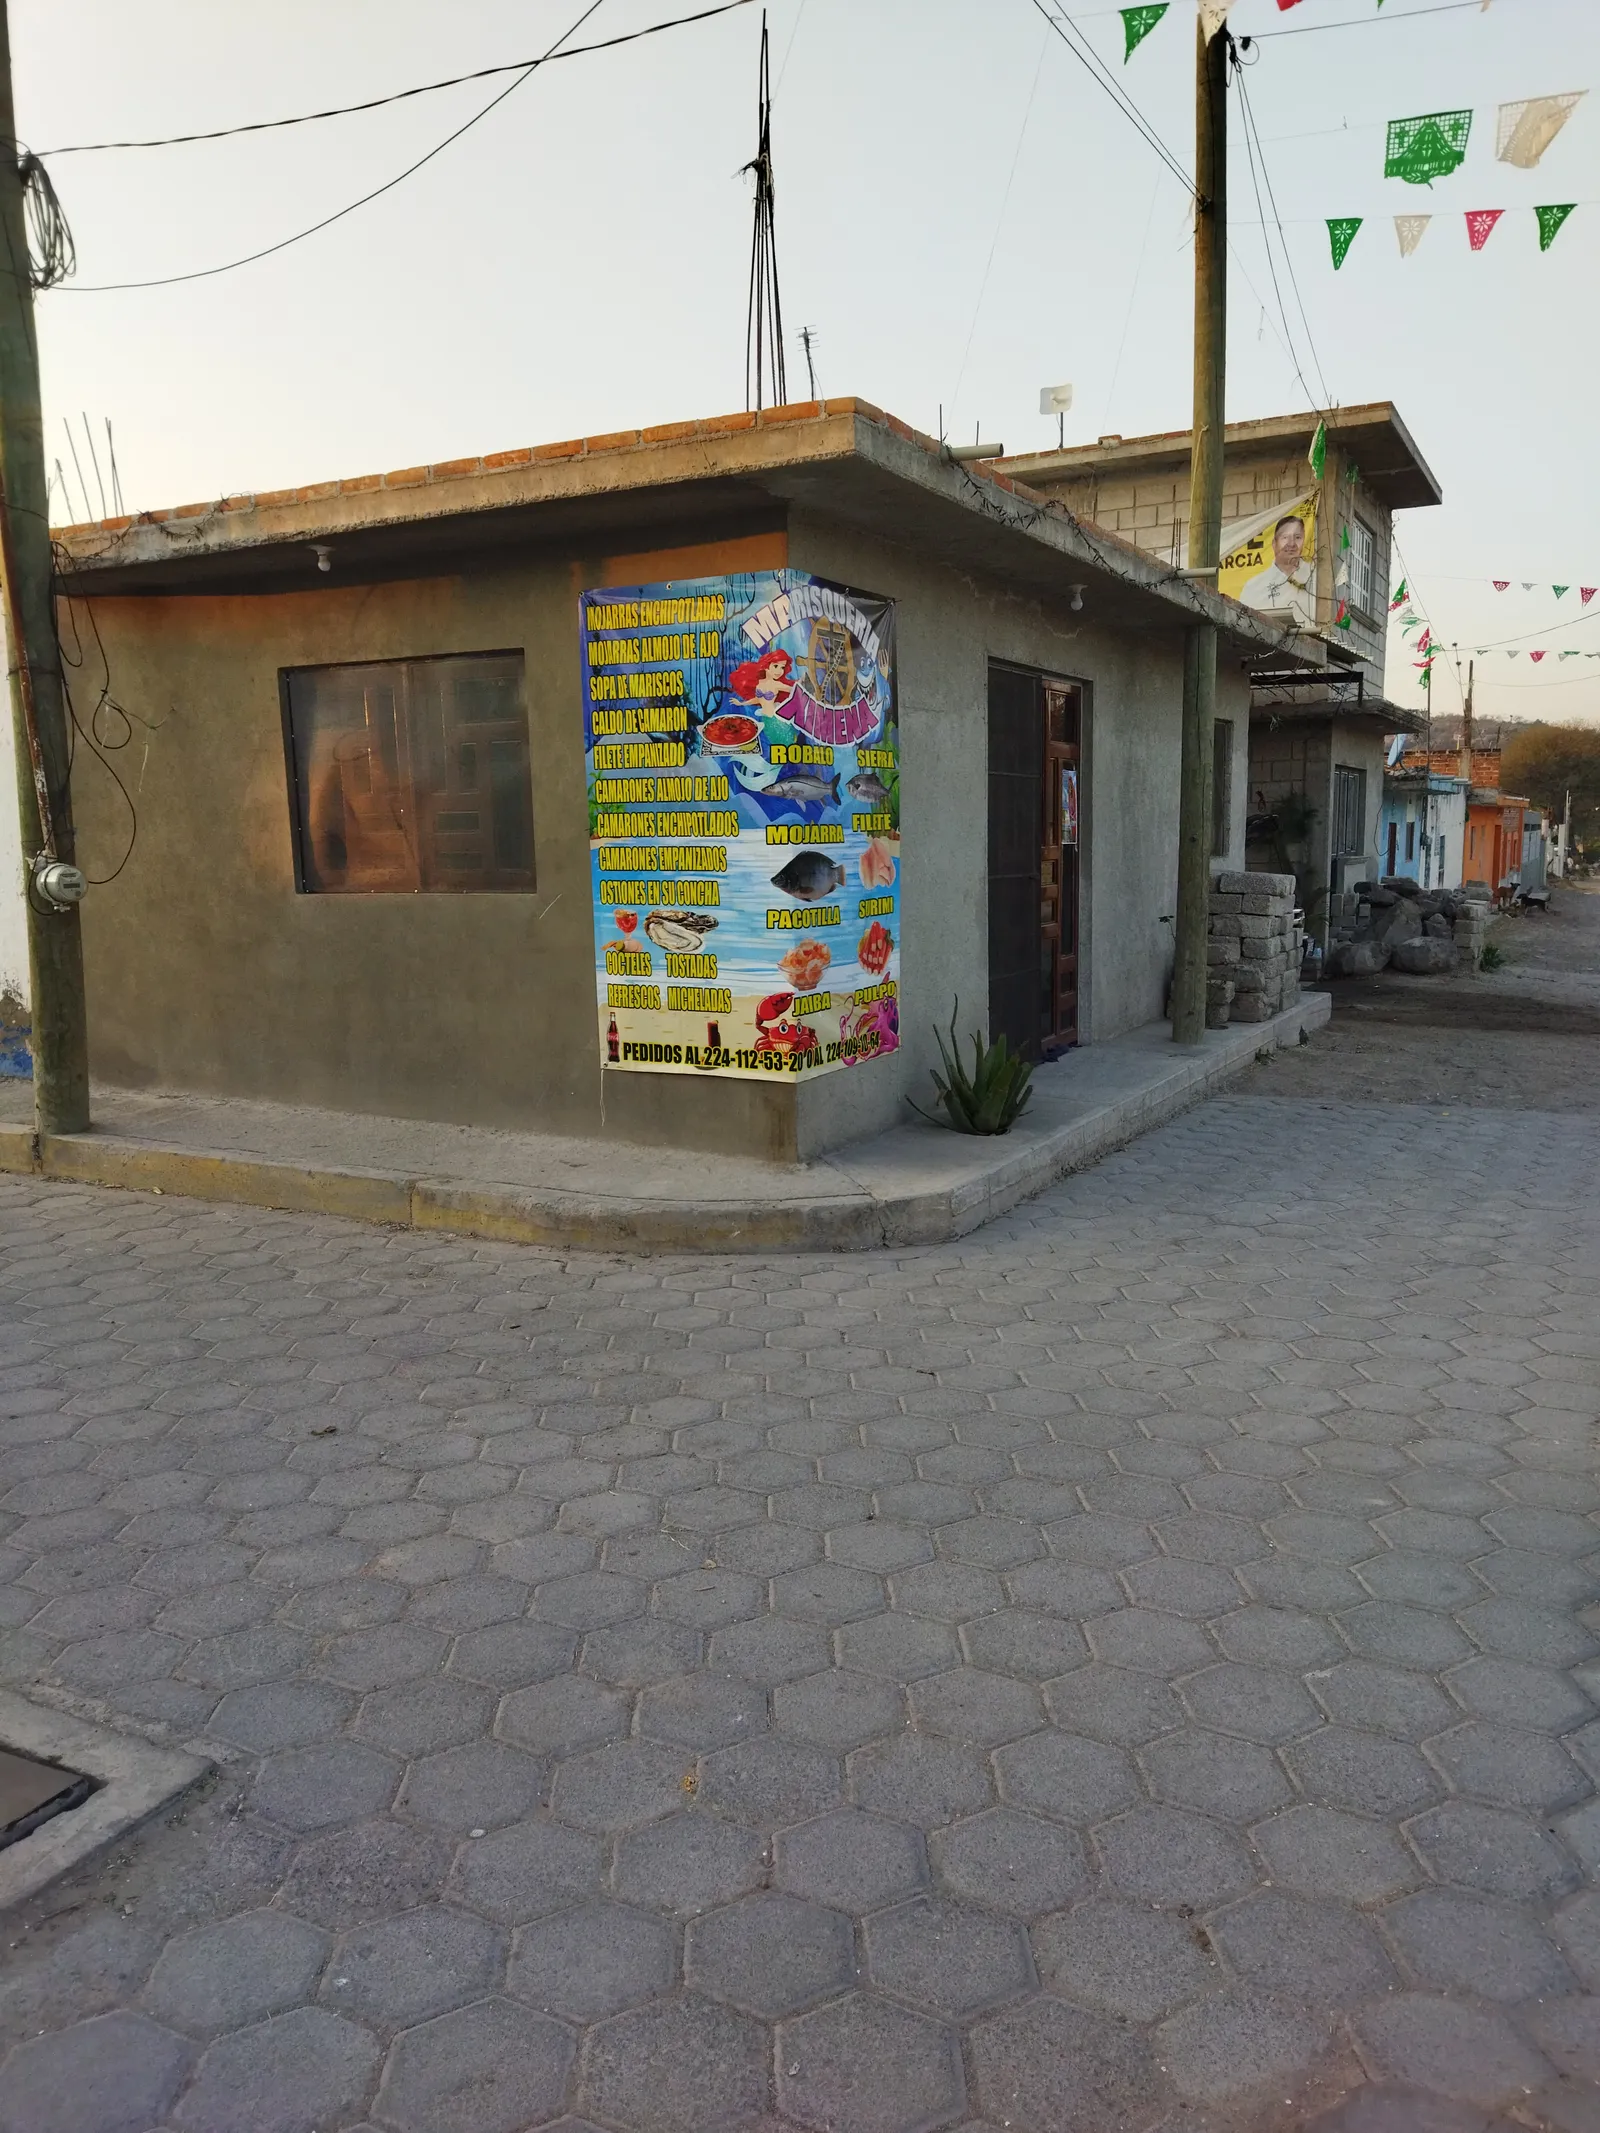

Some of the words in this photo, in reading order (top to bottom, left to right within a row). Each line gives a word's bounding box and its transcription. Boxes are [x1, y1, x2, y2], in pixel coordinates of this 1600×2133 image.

[587, 603, 638, 631] MOJARRAS
[640, 594, 724, 627] ENCHIPOTLADAS
[741, 584, 880, 662] MARISQUERIA
[588, 638, 640, 666] MOJARRAS
[682, 633, 696, 660] DE
[700, 631, 719, 658] AJO
[590, 675, 616, 701] SOPA
[617, 674, 629, 699] DE
[629, 670, 684, 698] MARISCOS
[592, 710, 623, 735] CALDO
[625, 709, 638, 733] DE
[637, 706, 688, 733] CAMARON
[775, 683, 880, 746] XIMENA
[594, 744, 623, 769] FILETE
[623, 742, 685, 768] EMPANIZADO
[770, 744, 834, 766] ROBALO
[857, 749, 895, 769] SIERRA
[596, 778, 655, 803] CAMARONES
[694, 776, 708, 801] DE
[709, 775, 729, 801] AJO
[597, 812, 655, 838] CAMARONES
[657, 811, 739, 837] ENCHIPOTLADOS
[766, 824, 844, 845] MOJARRA
[852, 813, 891, 832] FILETE
[599, 846, 657, 871] CAMARONES
[659, 846, 727, 872] EMPANIZADOS
[600, 880, 646, 905] OSTIONES
[647, 880, 660, 905] EN
[661, 880, 675, 906] SU
[676, 880, 720, 906] CONCHA
[766, 906, 841, 929] PACOTILLA
[859, 897, 893, 918] SURIMI
[605, 951, 652, 977] COCTELES
[665, 953, 718, 979] TOSTADAS
[607, 984, 661, 1010] REFRESCOS
[667, 986, 732, 1014] MICHELADAS
[792, 991, 831, 1017] JAIBA
[854, 981, 897, 1006] PULPO
[623, 1042, 682, 1064] PEDIDOS
[685, 1046, 700, 1065] AL
[703, 1047, 803, 1072] 224-112-53-20
[814, 1046, 823, 1066] AL
